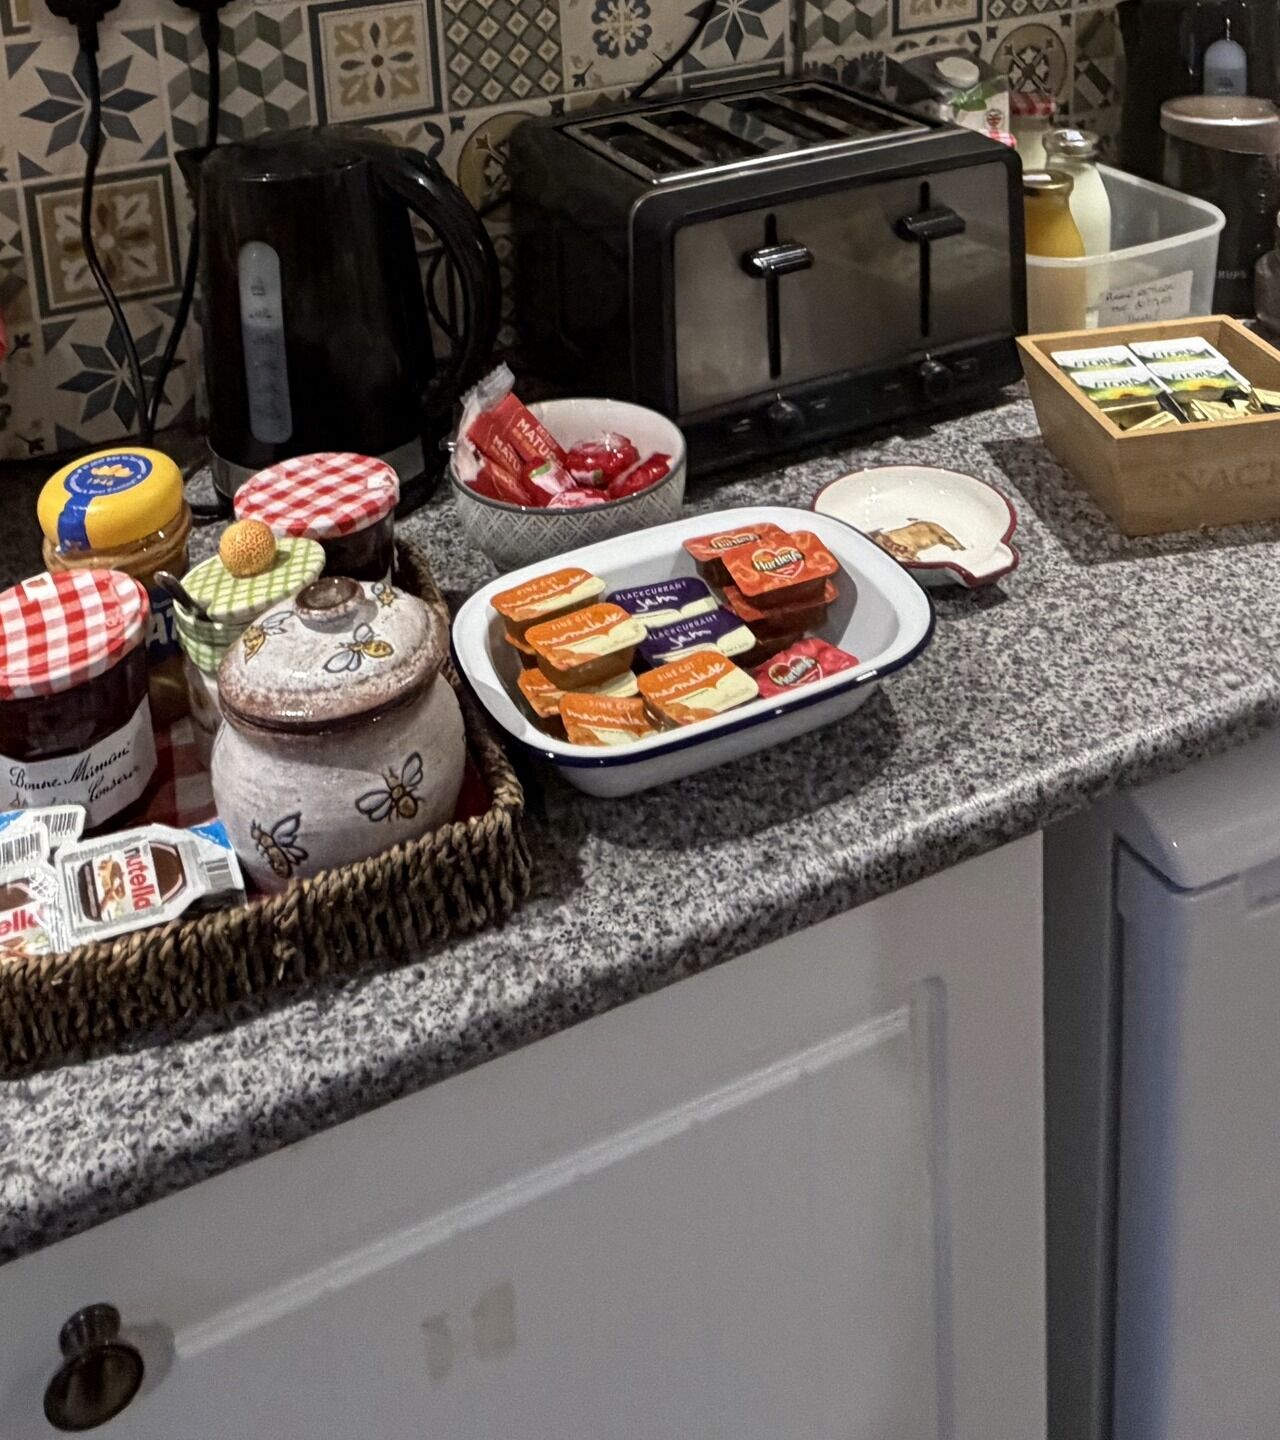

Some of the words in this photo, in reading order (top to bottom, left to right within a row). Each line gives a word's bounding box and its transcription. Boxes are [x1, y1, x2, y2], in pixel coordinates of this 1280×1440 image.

[754, 550, 804, 572] Hartley's
[615, 581, 688, 602] BLACKCURRANT
[9, 766, 61, 791] Bonne
[124, 846, 155, 911] nutella
